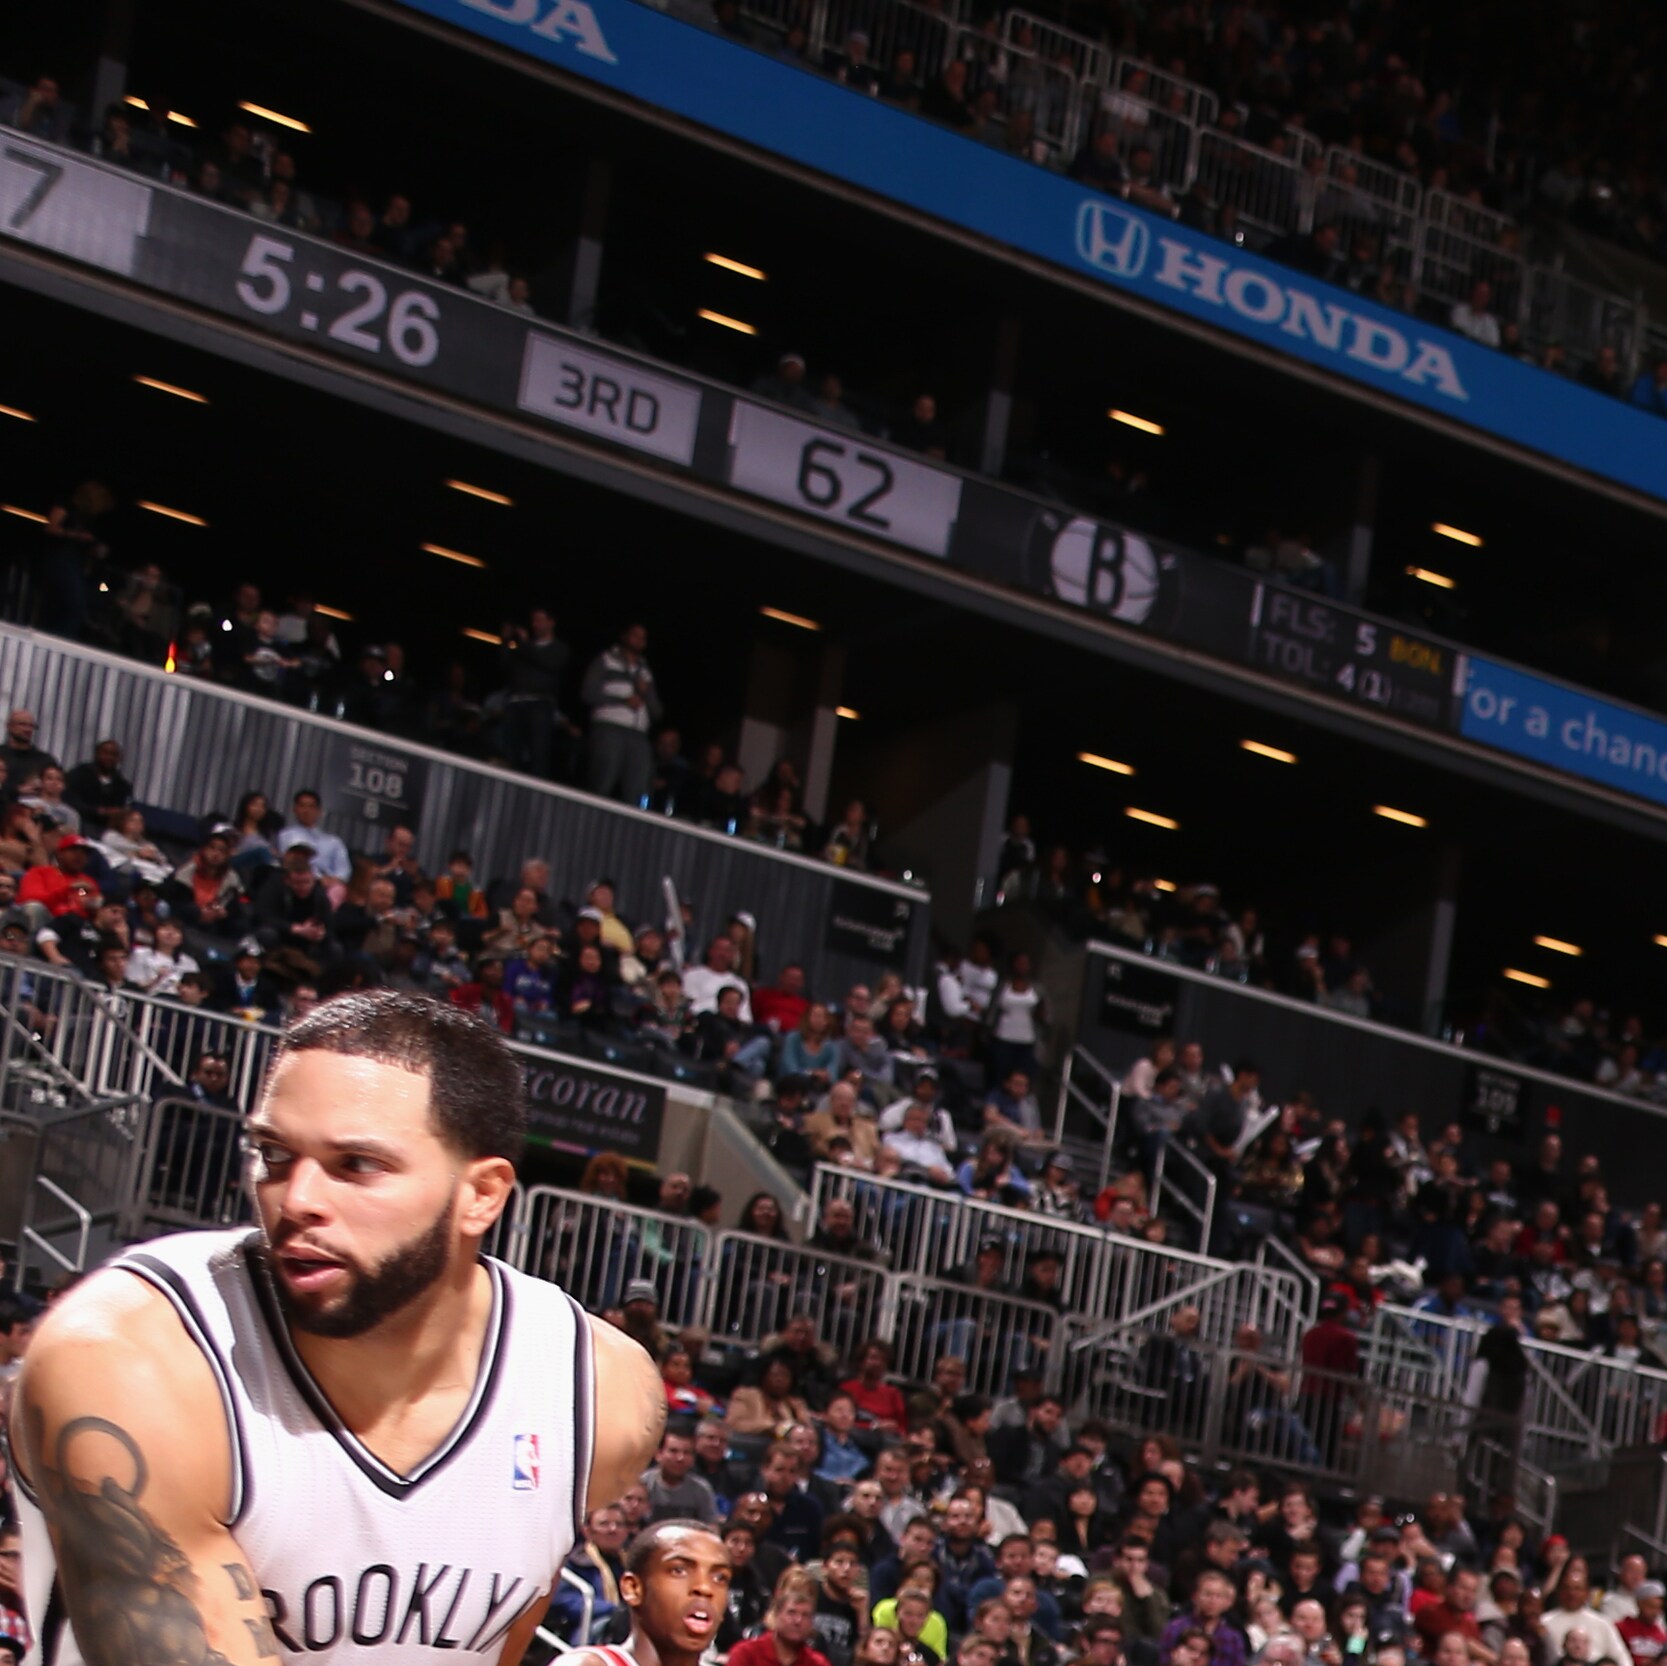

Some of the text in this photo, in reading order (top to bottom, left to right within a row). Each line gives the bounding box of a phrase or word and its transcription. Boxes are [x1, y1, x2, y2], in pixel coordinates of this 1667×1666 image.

[236, 233, 441, 367] 5:26
[1157, 239, 1469, 401] HONDA
[554, 364, 661, 436] 3RD
[797, 438, 895, 529] 62
[1269, 591, 1335, 644] FLS:
[1354, 622, 1377, 656] 5
[1262, 630, 1330, 680] TOL:
[1334, 662, 1355, 693] 4
[1524, 706, 1550, 738] a
